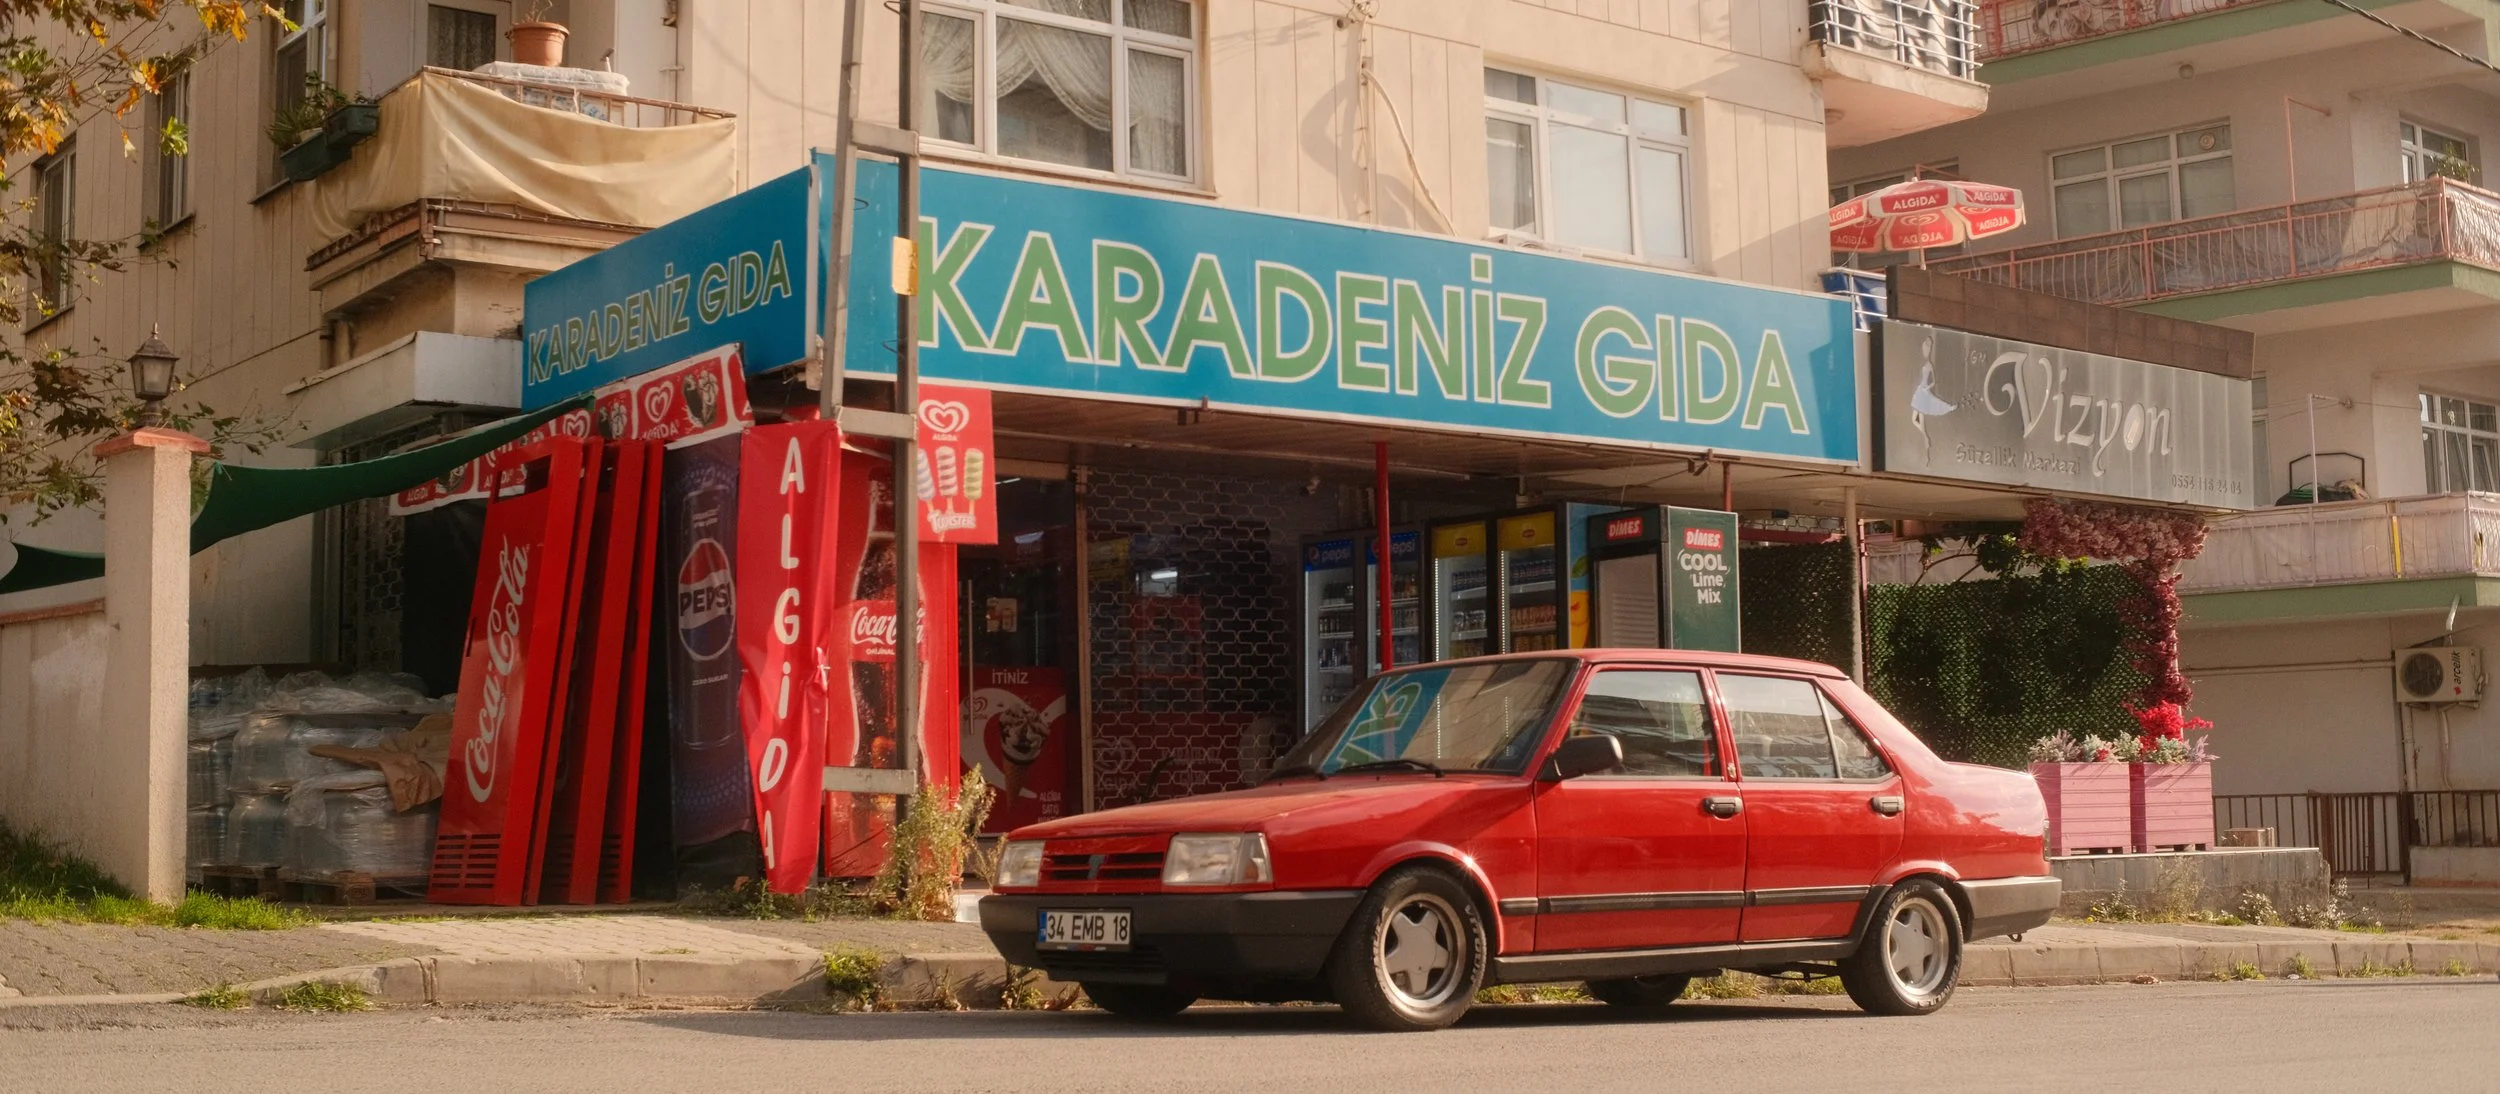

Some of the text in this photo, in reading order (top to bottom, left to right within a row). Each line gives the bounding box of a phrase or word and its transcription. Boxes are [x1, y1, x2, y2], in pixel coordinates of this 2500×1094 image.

[527, 239, 793, 386] KARADENİZ GIDA
[918, 216, 1810, 436] KARADENİZ GIDA
[1983, 350, 2173, 478] Vizyon
[1955, 443, 2017, 469] Güzellik
[1391, 538, 1415, 556] epsi
[1680, 553, 1728, 572] COOL
[1692, 571, 1724, 587] Lime
[679, 582, 732, 617] PEPSI
[1696, 589, 1722, 605] Mix
[465, 534, 530, 803] Coca-Cola
[1047, 914, 1129, 941] 34 EMB 18
